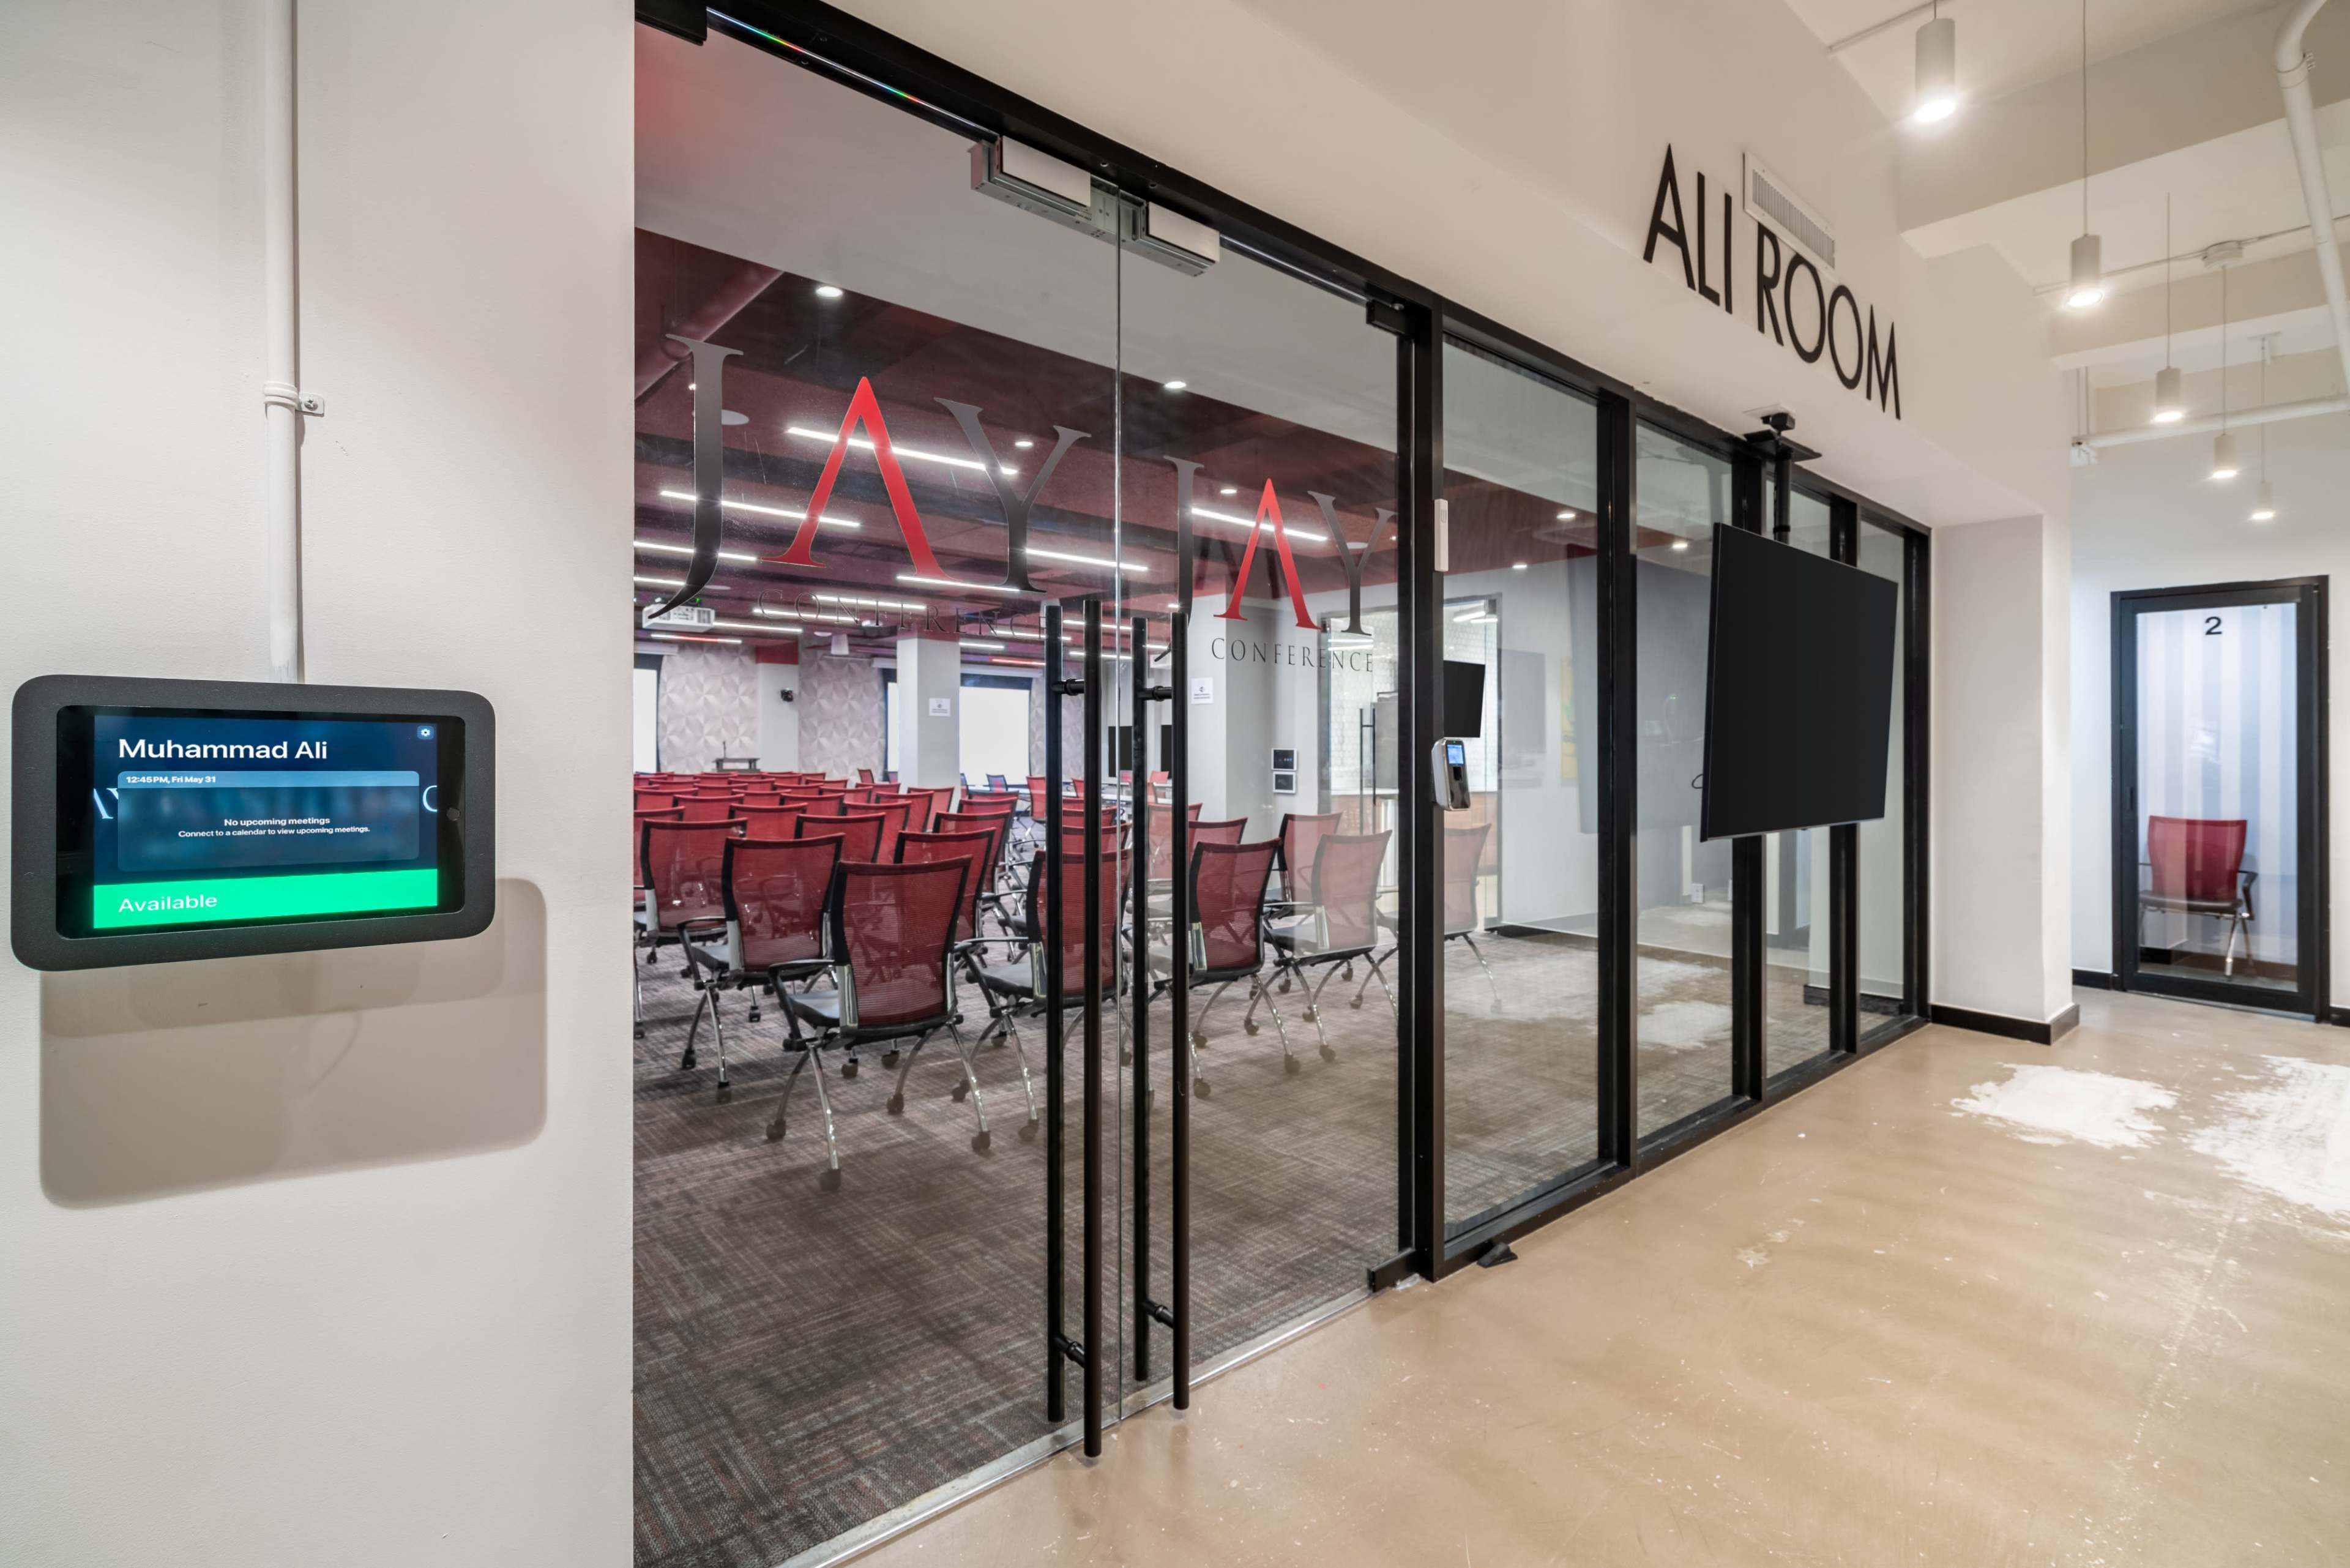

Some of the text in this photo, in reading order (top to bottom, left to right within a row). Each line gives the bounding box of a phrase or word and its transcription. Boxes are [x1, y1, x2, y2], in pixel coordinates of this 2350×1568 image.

[1643, 143, 1901, 420] ALI ROOM
[648, 334, 1091, 619] JAY
[1155, 455, 1398, 662] JAY
[2204, 616, 2223, 635] 2
[1211, 637, 1373, 672] CONFERENCE
[119, 739, 327, 759] Muhammad Ali
[288, 817, 330, 826] meetings
[118, 894, 217, 913] Available
